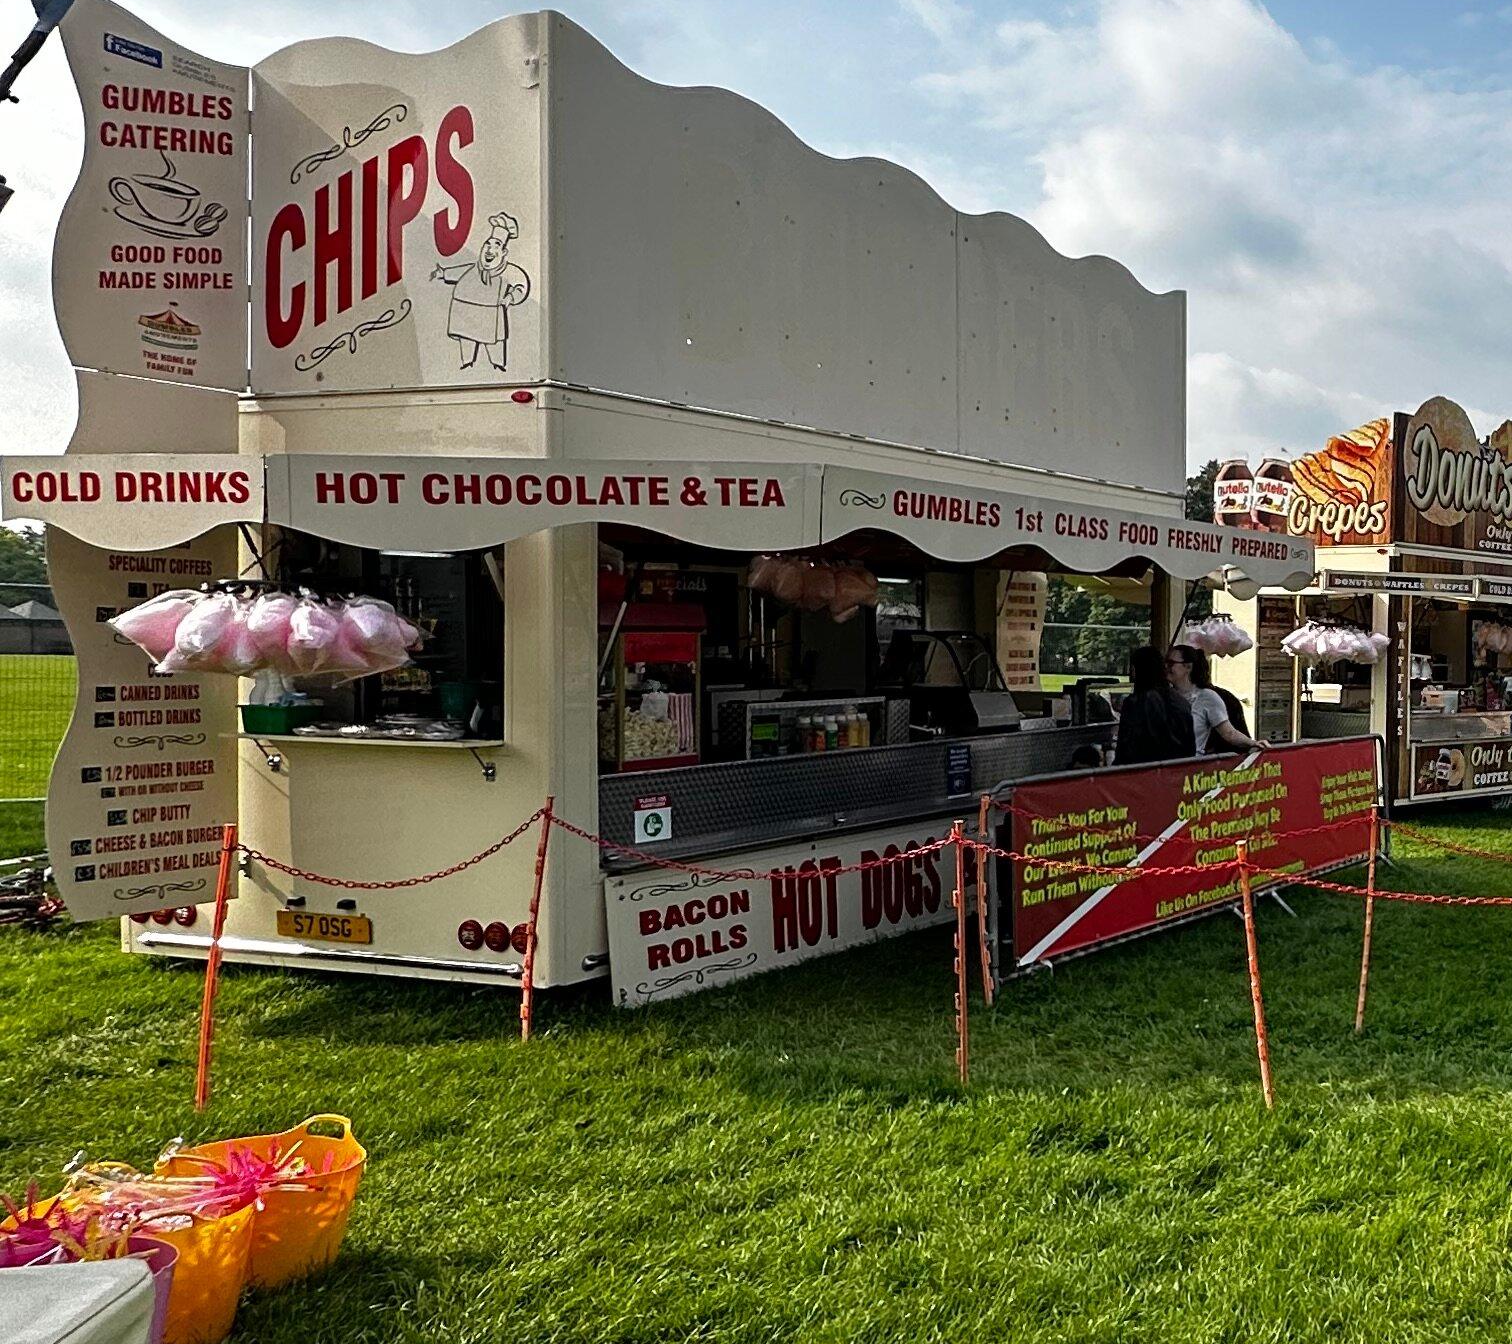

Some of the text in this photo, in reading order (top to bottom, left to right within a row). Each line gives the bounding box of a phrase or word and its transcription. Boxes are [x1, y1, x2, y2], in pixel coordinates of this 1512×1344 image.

[101, 84, 233, 120] GUMBLES
[100, 121, 233, 155] CATERING
[265, 105, 475, 349] CHIPS
[111, 245, 222, 264] GOOD FOOD
[99, 271, 233, 289] MADE SIMPLE
[142, 350, 197, 366] THE HOME OF
[146, 361, 193, 376] FAMILY FUN
[12, 471, 249, 503] COLD DRINKS
[316, 472, 786, 507] HOT CHOCOLATE & TEA
[1218, 481, 1250, 497] nutella
[1256, 481, 1289, 496] nutella
[893, 490, 1288, 561] GUMBLES 1st CLASS FOOD FRESHLY PREPARED
[1289, 494, 1387, 543] Crepes
[1486, 524, 1512, 542] Only
[1478, 539, 1512, 551] COFFEE
[109, 555, 212, 575] SPECIALITY COFFEES
[1334, 578, 1469, 592] DONUTS WAFFLES CREPES
[1489, 584, 1507, 595] COLD
[1397, 621, 1407, 736] WAFFLES
[120, 686, 161, 701] CANNED
[164, 685, 199, 700] DRINKS
[119, 709, 162, 726] BOTTLED
[166, 709, 201, 724] DRINKS
[1471, 744, 1503, 767] Only
[105, 765, 122, 782] 1/2
[125, 762, 172, 780] POUNDER
[176, 760, 214, 776] BURGER
[1473, 771, 1509, 785] COFFEE
[1183, 775, 1192, 794] A
[1193, 770, 1217, 792] Kind
[1178, 799, 1202, 821] Only
[1204, 793, 1230, 814] Food
[1276, 783, 1288, 798] On
[132, 807, 156, 824] CHIP
[160, 804, 191, 821] BUTTY
[1068, 813, 1086, 827] You
[1089, 809, 1105, 825] For
[1107, 807, 1128, 822] Your
[95, 834, 136, 854] CHEESE
[139, 835, 146, 849] &
[150, 830, 183, 848] BACON
[1191, 825, 1209, 843] The
[1024, 833, 1081, 858] Continued
[100, 857, 160, 879] CHILDREN'S
[163, 854, 189, 872] MEAL
[193, 851, 221, 868] DEALS
[1196, 845, 1237, 867] Consum
[1024, 865, 1044, 883] Our
[770, 856, 842, 953] HOT
[860, 836, 942, 930] DOGS
[1047, 881, 1077, 900] Them
[639, 889, 750, 936] BACON
[1156, 900, 1174, 918] Like
[294, 915, 314, 934] S7
[648, 924, 748, 971] ROLLS
